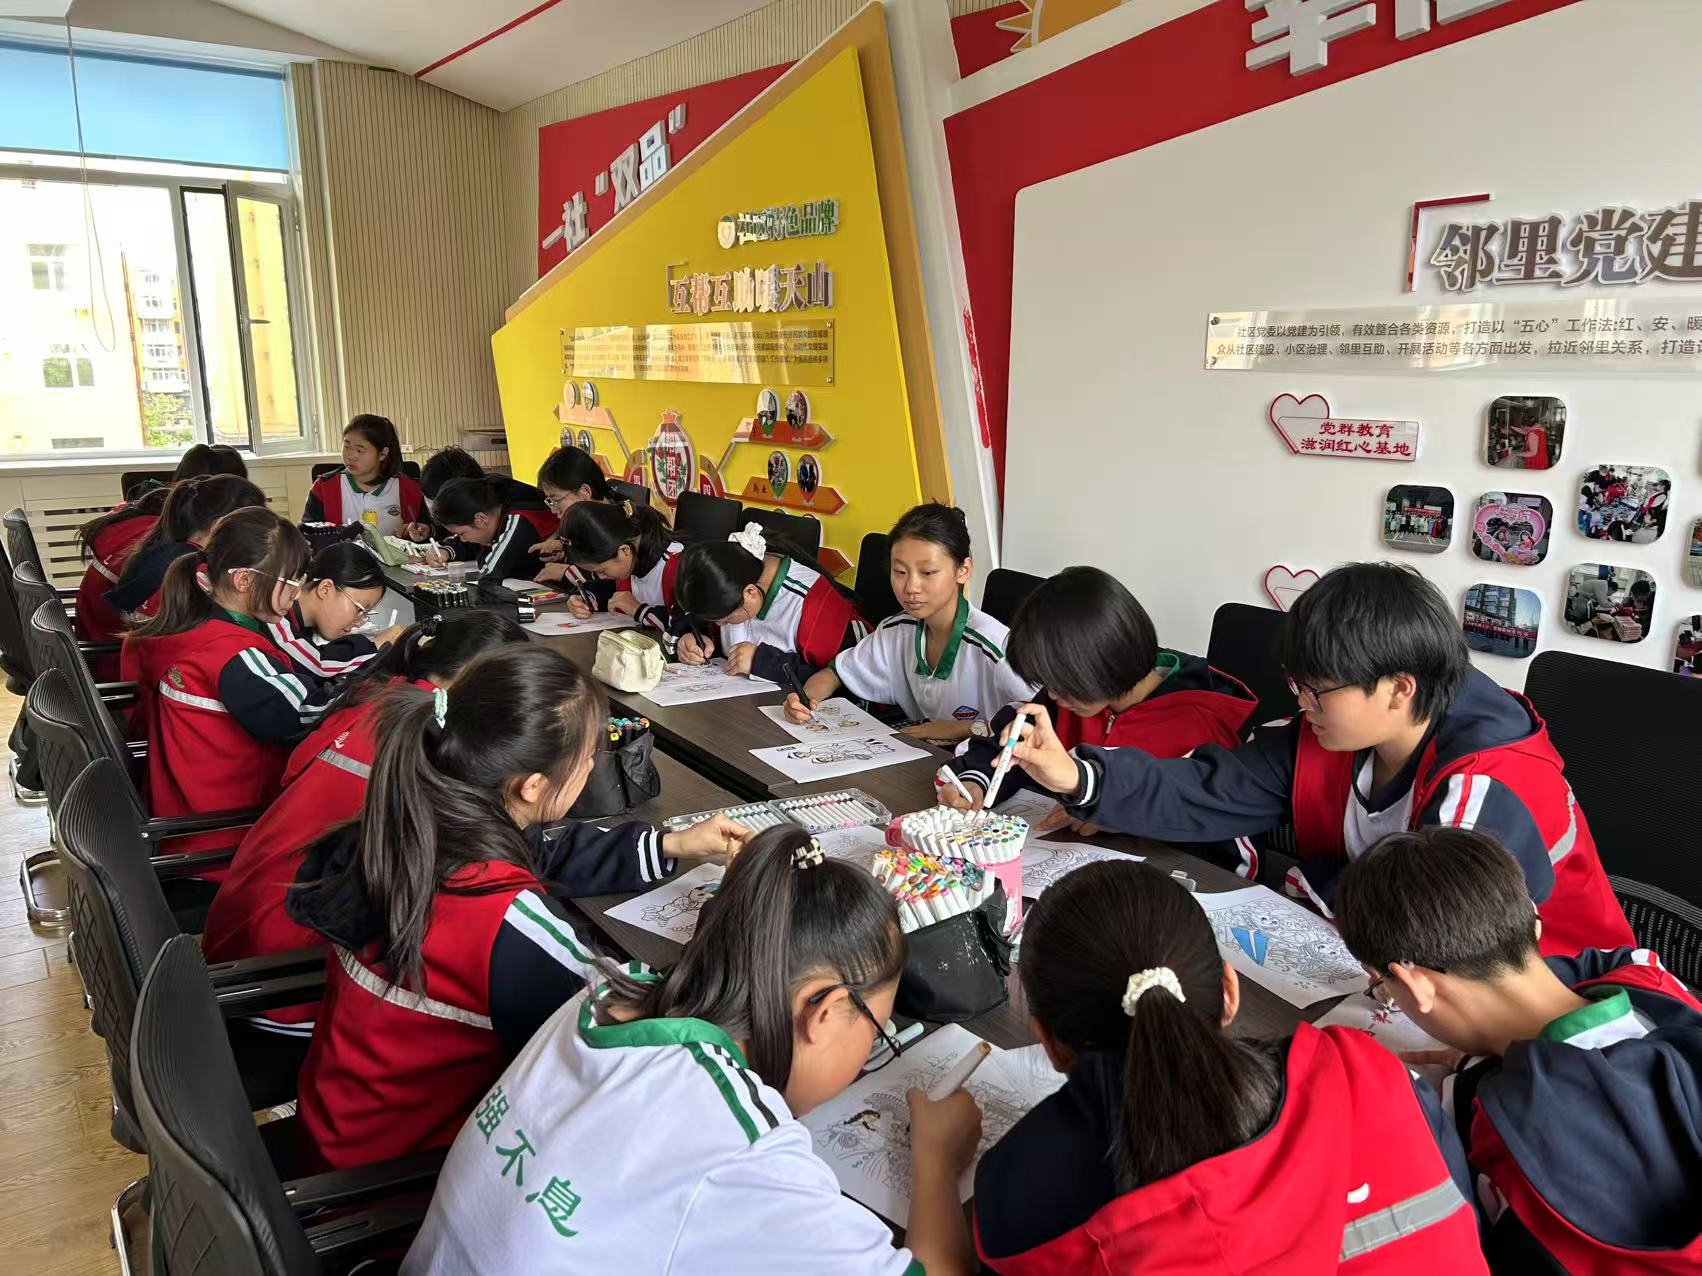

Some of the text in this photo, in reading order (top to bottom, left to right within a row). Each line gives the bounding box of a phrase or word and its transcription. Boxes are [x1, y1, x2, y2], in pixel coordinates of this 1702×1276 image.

[1431, 199, 1702, 292] 邻里党建
[1300, 437, 1412, 457] 滋润红心基地
[1318, 421, 1394, 439] 党群教育
[475, 1084, 582, 1238] 强不息
